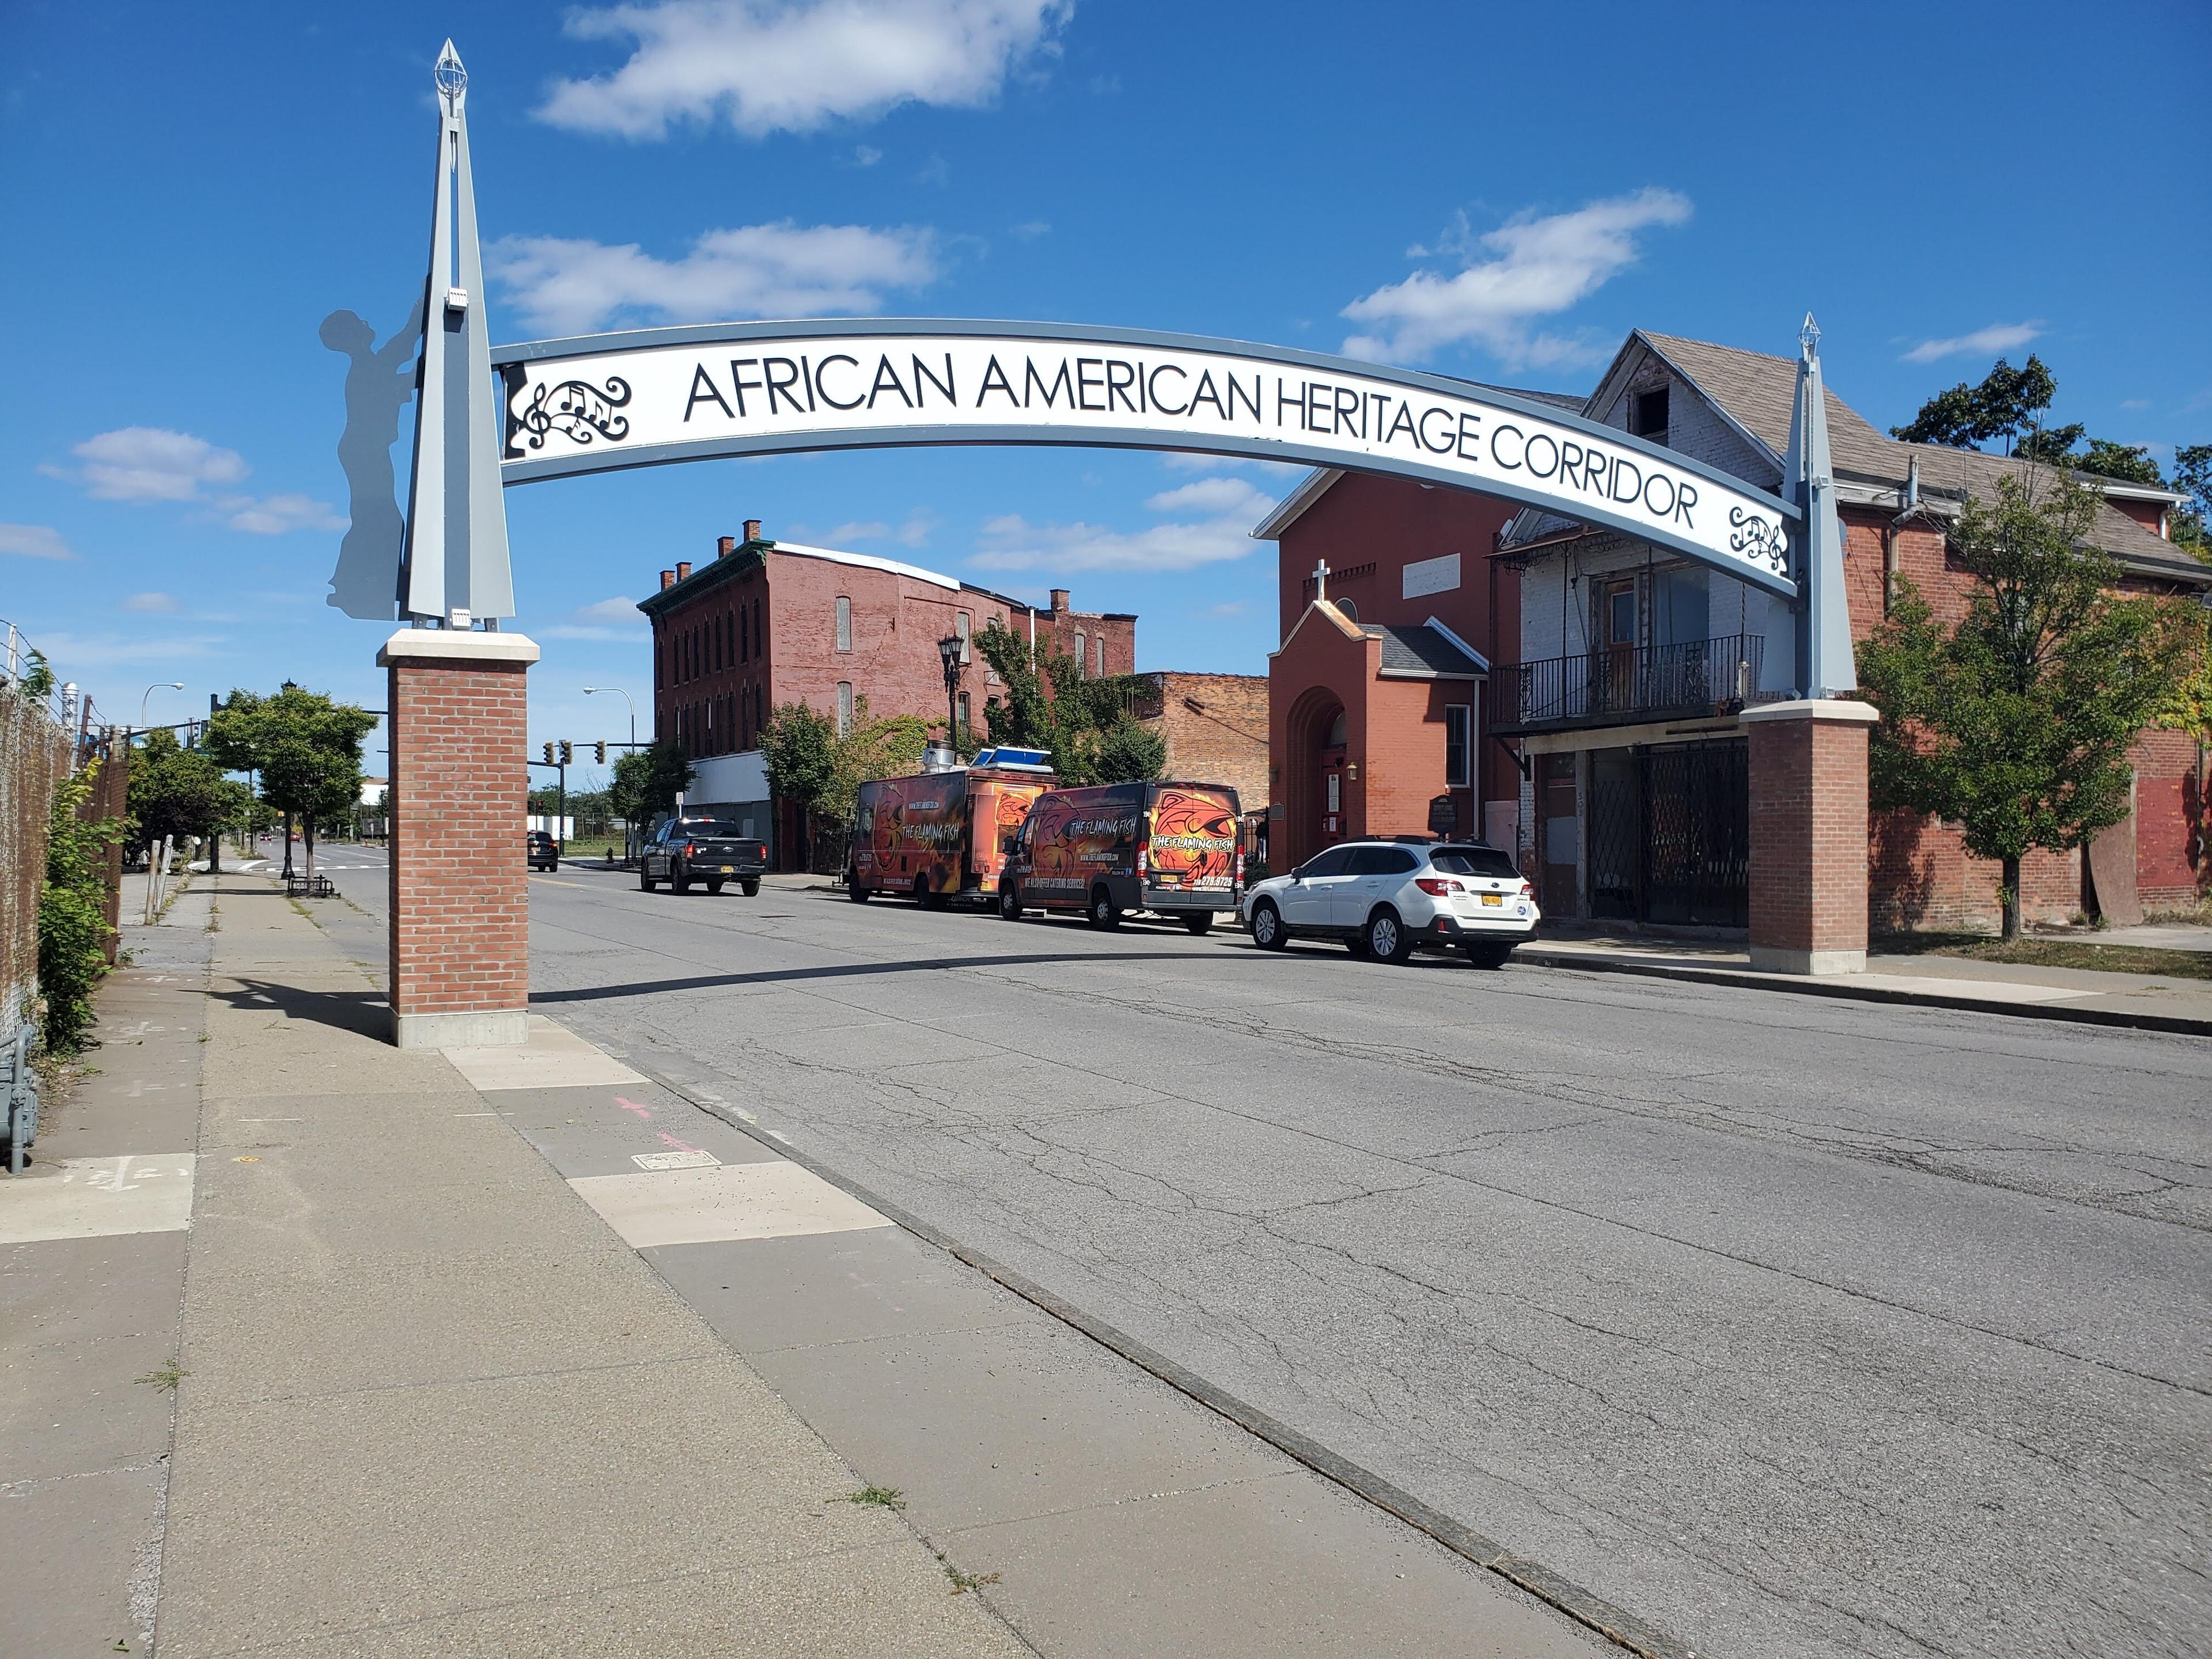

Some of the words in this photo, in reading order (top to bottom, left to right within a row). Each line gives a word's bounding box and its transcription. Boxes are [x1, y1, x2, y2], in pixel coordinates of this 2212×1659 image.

[684, 353, 957, 422] AFRICAN
[976, 354, 1261, 424] AMERICAN
[1278, 378, 1481, 462] HERITAGE
[1491, 425, 1698, 529] CORRIDOR
[902, 823, 915, 839] THE
[915, 821, 942, 843] FLAMING
[944, 822, 959, 840] FISH
[1071, 819, 1086, 835] THE
[1086, 817, 1118, 838] FLAMING
[1119, 817, 1137, 835] FISH
[1152, 835, 1171, 848] THE
[1172, 837, 1213, 852] FLAMING
[1214, 838, 1234, 850] FISH
[1025, 878, 1031, 888] WE
[1031, 878, 1039, 888] ALSO
[1039, 878, 1050, 888] OFFER
[1050, 878, 1066, 888] CATERING
[1067, 878, 1085, 889] SERVICES!
[1201, 876, 1233, 887] 279.9725
